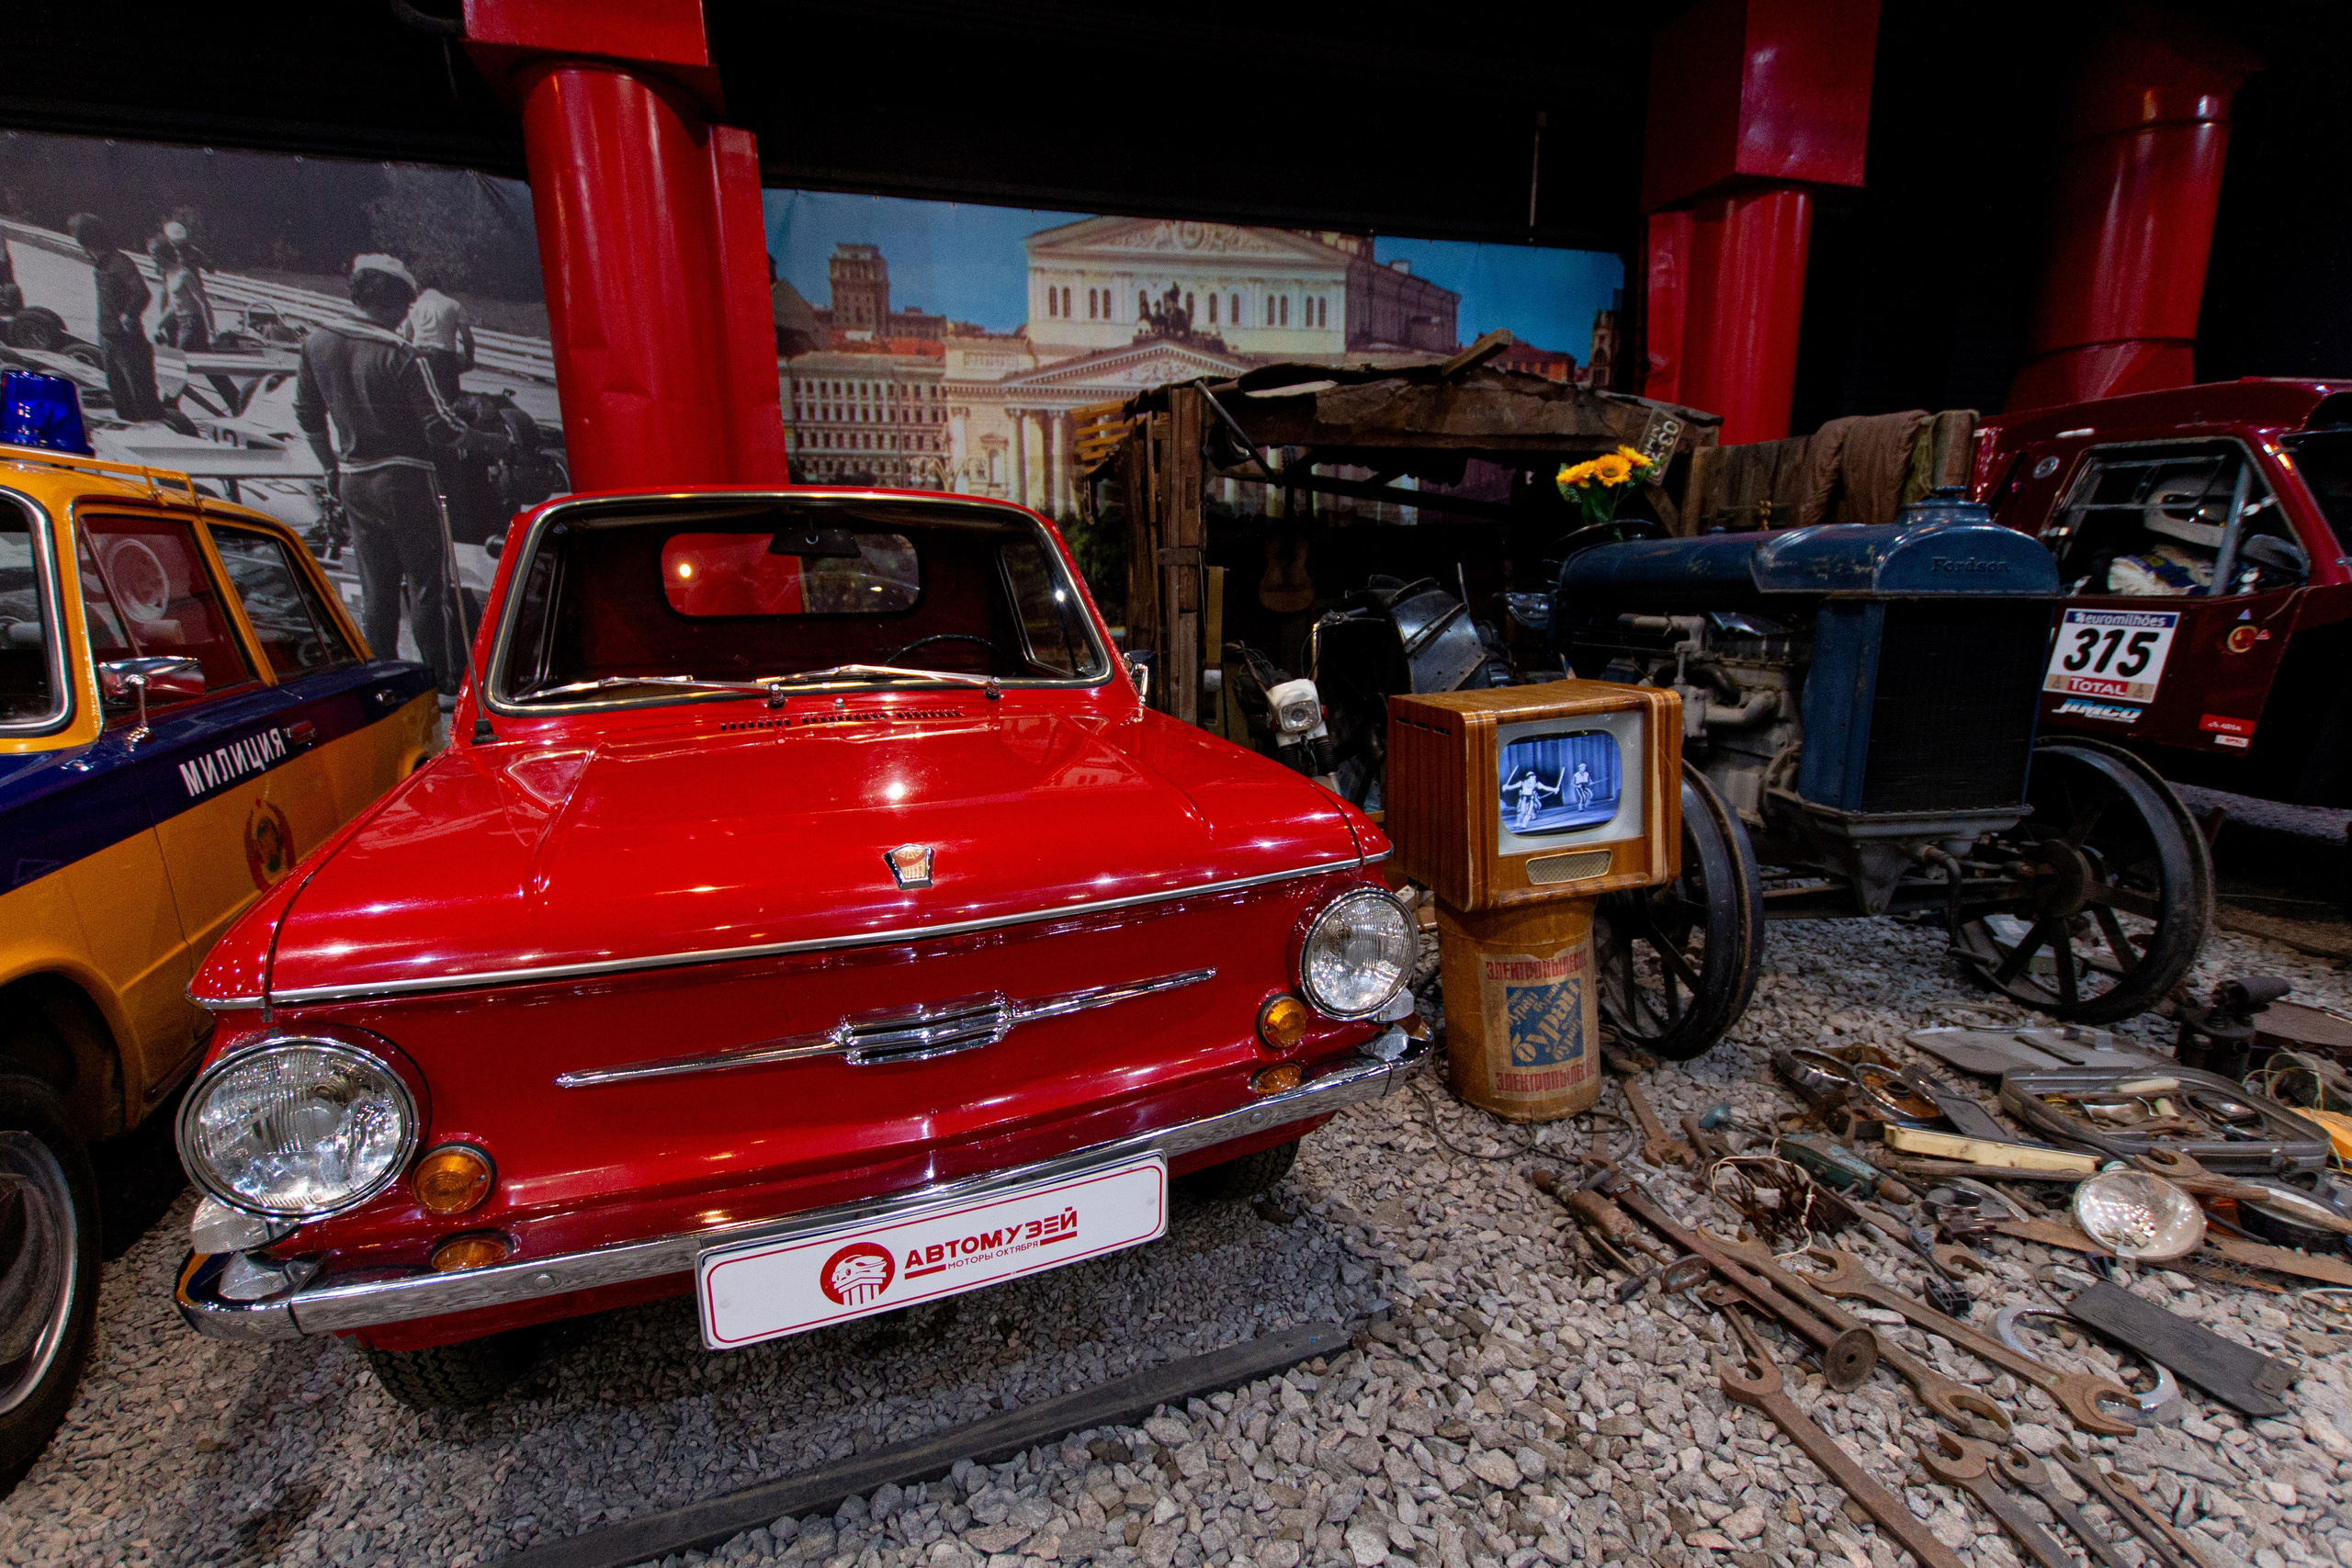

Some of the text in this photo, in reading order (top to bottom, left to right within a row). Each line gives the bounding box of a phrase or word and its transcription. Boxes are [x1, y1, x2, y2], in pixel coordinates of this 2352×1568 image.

[1931, 557, 2009, 572] Fordson
[2085, 613, 2166, 627] euromilhões
[2064, 628, 2160, 678] 315
[2070, 678, 2126, 696] TOTAL
[178, 728, 287, 797] МИЛИЦИЯ
[1511, 981, 1581, 1063] буран
[904, 1205, 1078, 1269] АВТОМУЗЕЙ
[947, 1240, 1039, 1269] МОТОРЫ ОКТЯБРЯ
